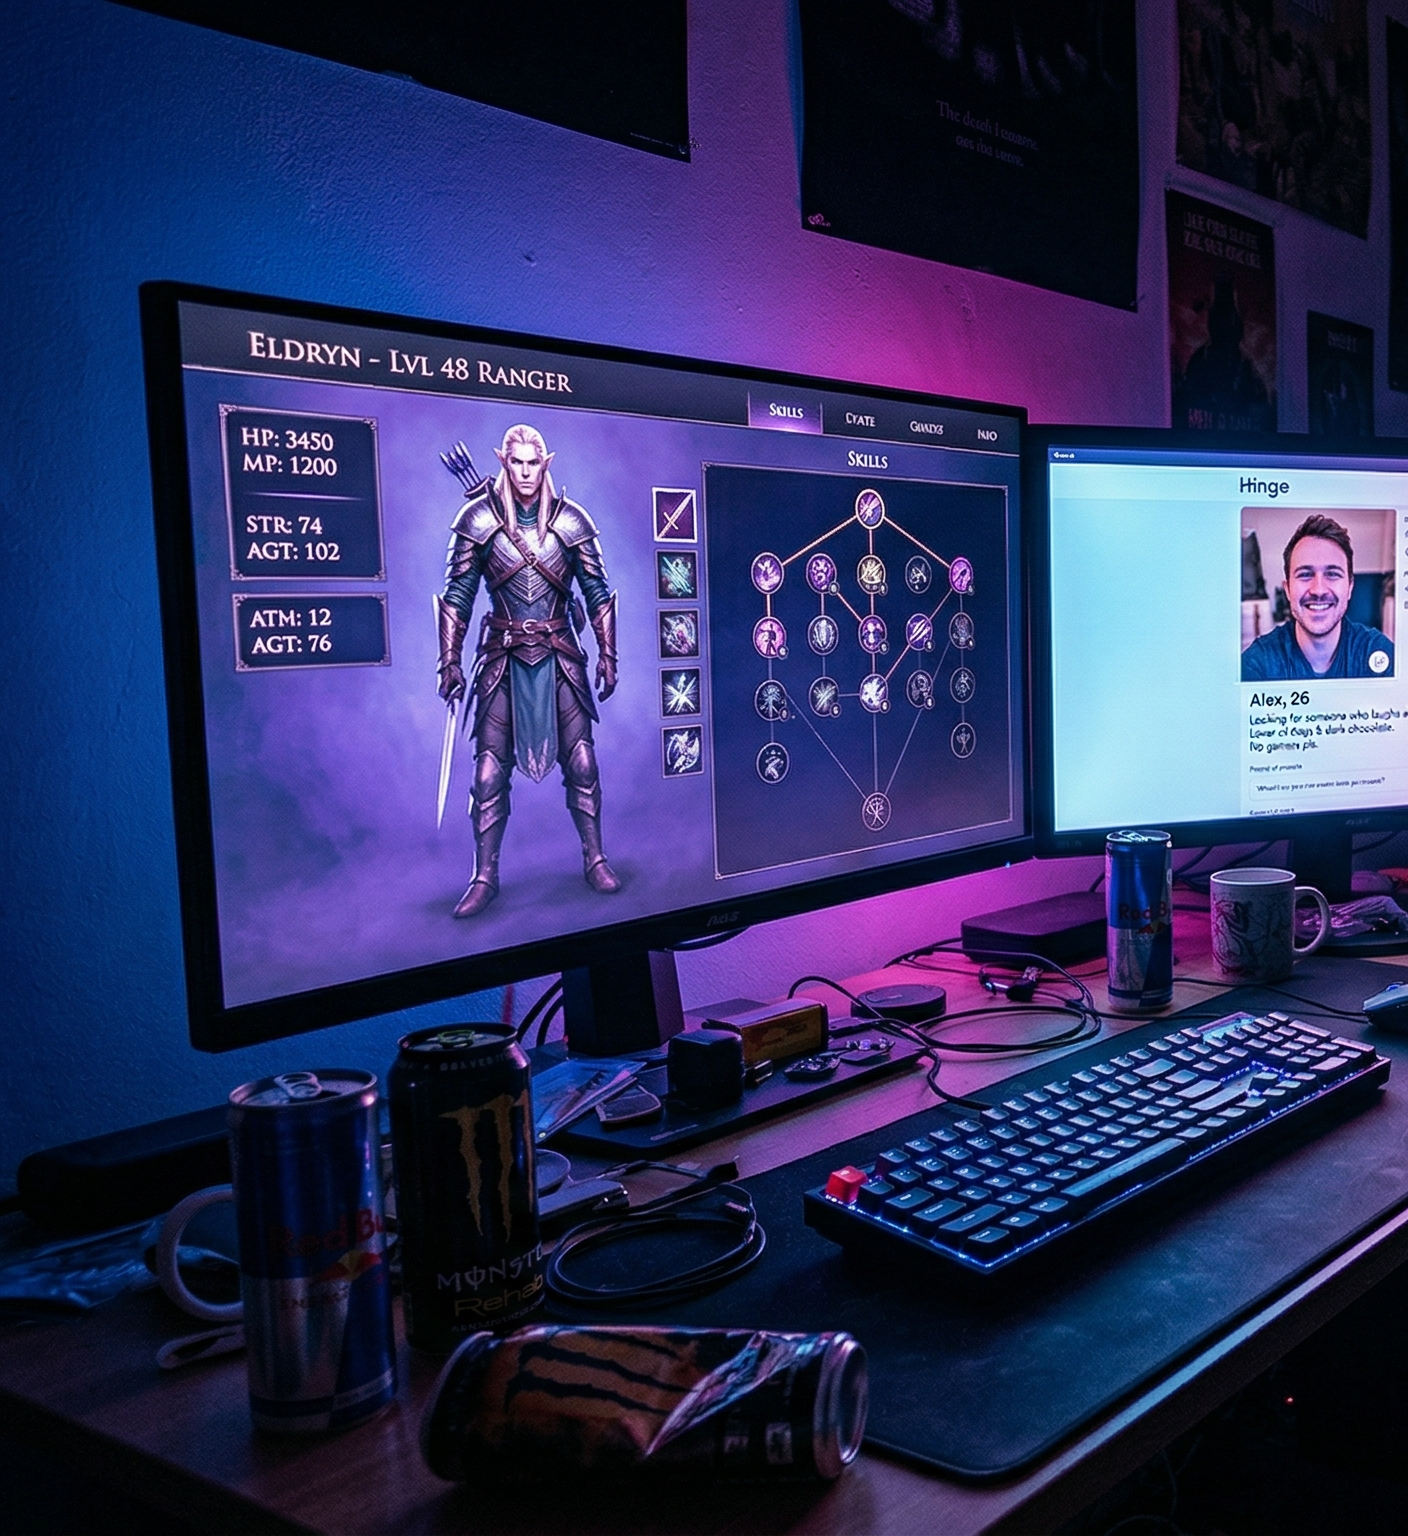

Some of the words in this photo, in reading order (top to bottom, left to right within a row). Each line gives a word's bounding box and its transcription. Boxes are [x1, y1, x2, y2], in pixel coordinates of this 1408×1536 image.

[247, 330, 361, 368] ELDRYN
[389, 349, 434, 377] LVL
[440, 358, 469, 380] 48
[477, 361, 572, 393] RANGER
[241, 427, 280, 447] HP:
[285, 430, 334, 451] 3450
[243, 453, 283, 473] MP:
[289, 456, 337, 476] 1200
[848, 451, 888, 469] SKILLS
[1240, 477, 1290, 498] Hinge
[247, 515, 293, 534] STR:
[298, 517, 322, 534] 74
[247, 542, 299, 560] AGT:
[304, 542, 340, 561] 102
[250, 610, 302, 627] ATM:
[308, 608, 332, 626] 12
[252, 636, 302, 654] AGT:
[308, 634, 332, 652] 76
[1250, 693, 1287, 709] Alex,
[1290, 691, 1310, 705] 26
[266, 1213, 349, 1259] Red
